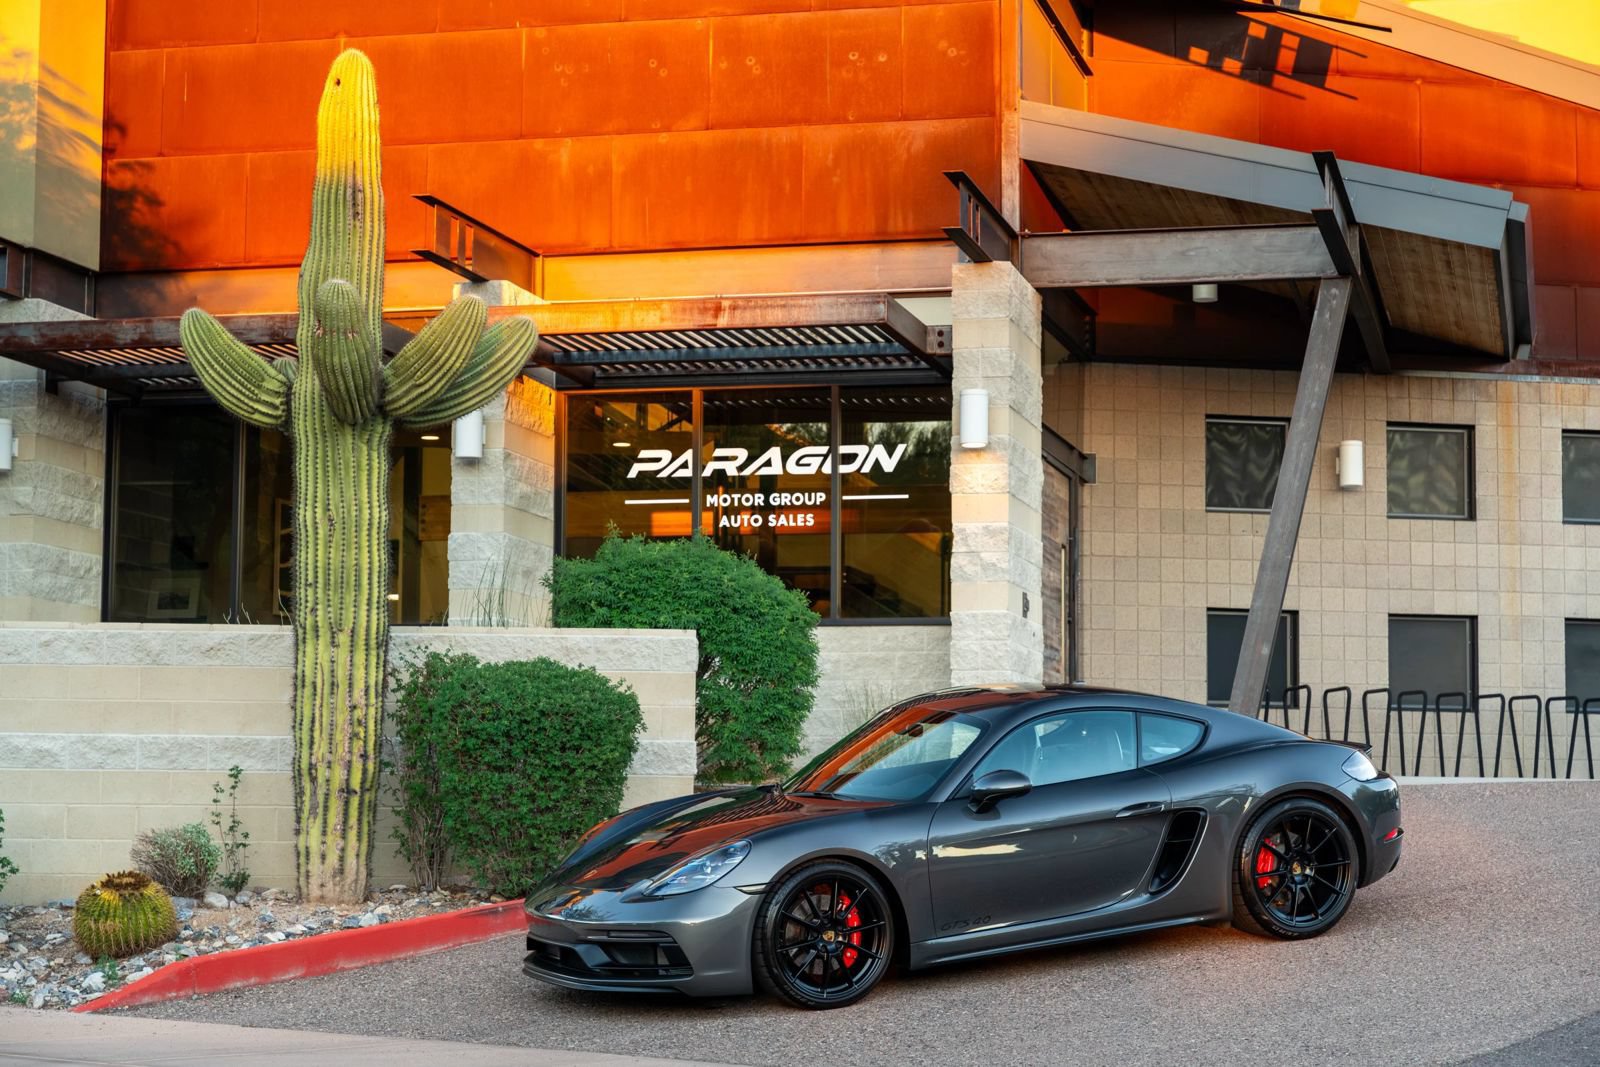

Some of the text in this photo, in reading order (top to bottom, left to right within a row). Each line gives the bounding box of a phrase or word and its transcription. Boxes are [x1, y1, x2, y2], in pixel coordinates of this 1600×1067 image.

[626, 444, 907, 479] PARAGON
[706, 492, 826, 508] MOTOR GROUP
[719, 513, 815, 528] AUTO SALES
[941, 919, 970, 931] GTS
